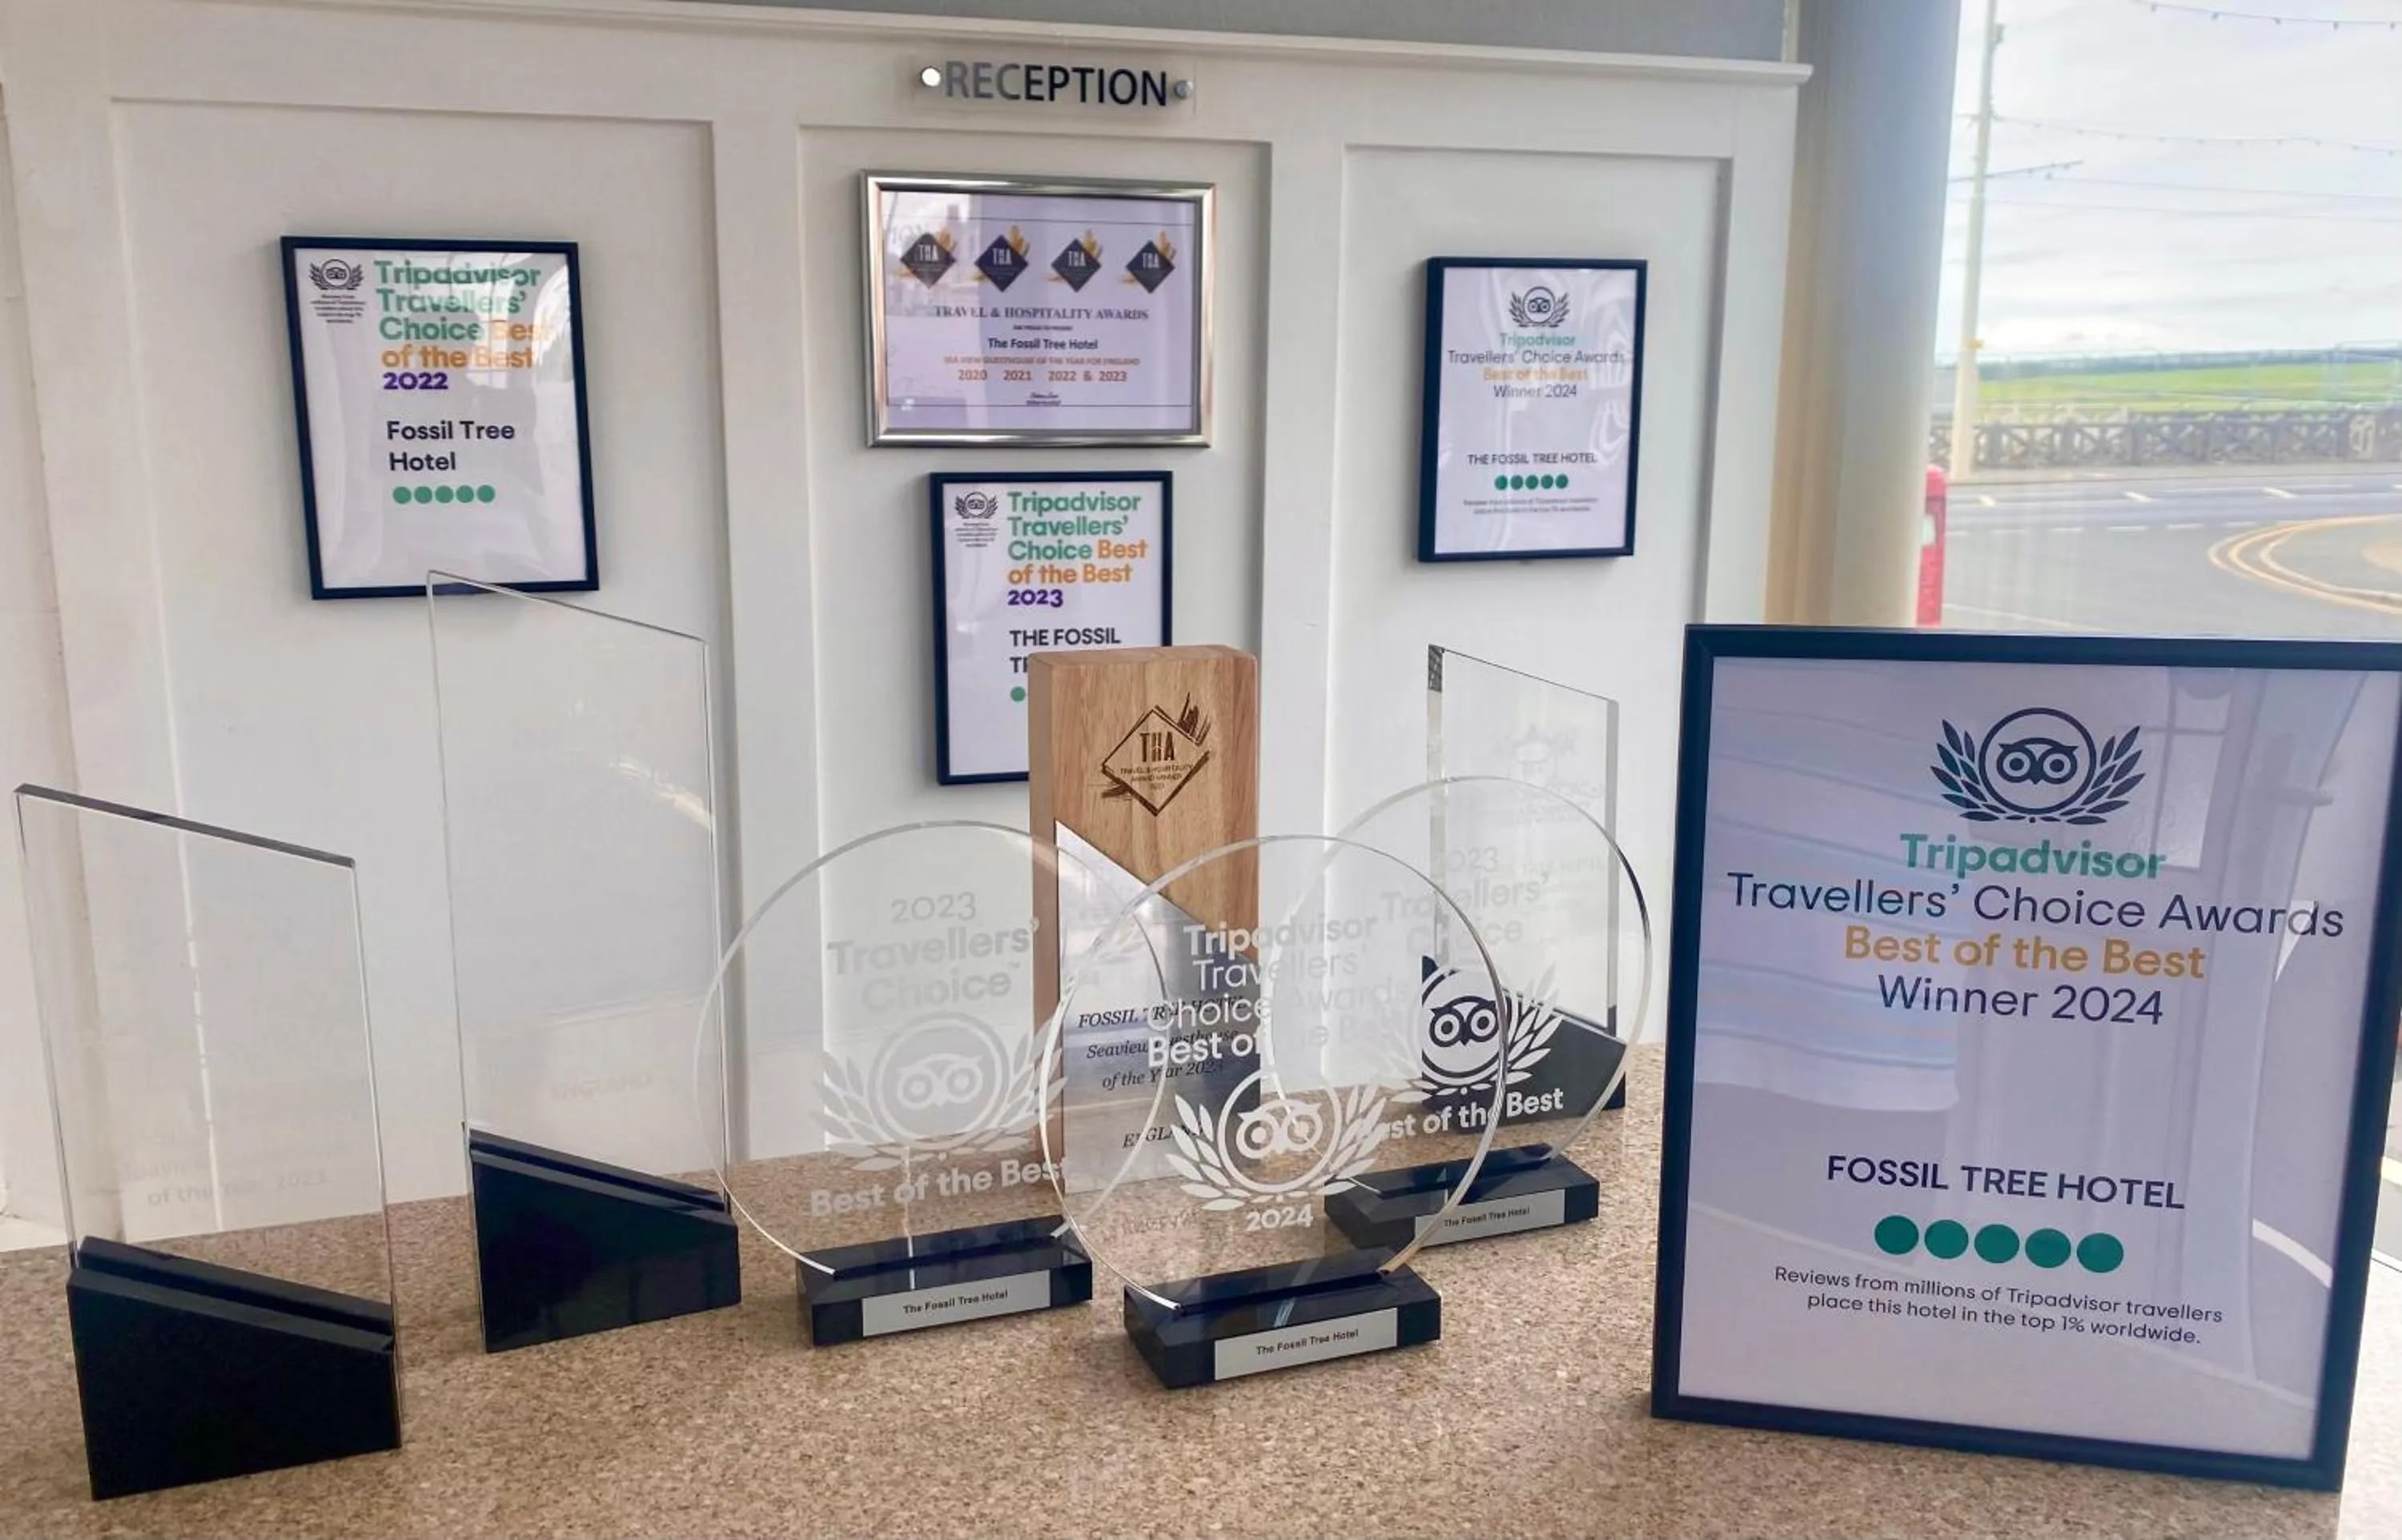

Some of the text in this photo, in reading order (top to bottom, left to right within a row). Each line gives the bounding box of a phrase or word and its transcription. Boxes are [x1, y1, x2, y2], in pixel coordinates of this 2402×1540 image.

[946, 60, 1167, 106] RECEPTION
[374, 259, 541, 289] Tripadvisor
[934, 306, 1149, 320] TRAVEL & HOSPITALITY AWARDS
[379, 316, 552, 342] Choice Bes
[1500, 333, 1576, 347] Tripadvisor
[382, 344, 535, 368] of the Best
[988, 338, 1099, 350] The Fossil Tree Hotel
[1522, 350, 1573, 363] Choice
[1575, 350, 1624, 362] Awards
[383, 372, 448, 390] 2022
[958, 369, 987, 380] 2020
[1003, 369, 1031, 381] 2021
[1048, 371, 1076, 381] 2022
[1099, 371, 1127, 382] 2023
[1484, 367, 1513, 380] Best
[1516, 367, 1532, 380] of
[1560, 367, 1589, 380] Best
[1493, 384, 1577, 398] Winner 2024
[387, 420, 515, 440] Fossil Tree
[389, 452, 456, 471] Hotel
[1467, 451, 1597, 465] THE FOSSIL TREE HOTEL
[1006, 491, 1141, 517] Tripadvisor
[1007, 539, 1148, 560] Choice Best
[1008, 563, 1133, 584] of the Best
[1007, 589, 1063, 608] 2023
[1009, 628, 1121, 647] THE FOSSIL
[1139, 731, 1175, 762] THA
[1431, 845, 1500, 873] 023
[1900, 832, 2165, 880] Tripadvisor
[891, 891, 977, 923] 2023
[1974, 883, 2145, 929] Choice
[2159, 892, 2343, 937] Awards
[1183, 912, 1378, 960] Tripadvisor
[1845, 924, 2205, 978] Best of the Best
[1878, 974, 2163, 1025] Winner 2024
[1078, 1009, 1139, 1029] FOSSIL
[1147, 993, 1272, 1033] Choice
[1147, 1033, 1223, 1067] Best
[1102, 1073, 1119, 1090] of
[1121, 1069, 1146, 1087] the
[1149, 1065, 1183, 1082] Yar
[1422, 1104, 1452, 1135] of
[1506, 1087, 1565, 1118] Best
[810, 1185, 889, 1216] Best
[894, 1173, 930, 1203] of
[935, 1166, 992, 1197] the
[1826, 1155, 2185, 1209] FOSSIL TREE HOTEL
[1245, 1202, 1314, 1232] 2024
[1444, 1206, 1530, 1227] The Fossil Tree Hotel
[902, 1289, 1008, 1314] The Fossil Tree Hotel
[1774, 1265, 2223, 1323] Reviews from millions of Tripadvisor travellers
[1807, 1292, 2202, 1345] place this hotel in the top 1% worldwide.
[1255, 1329, 1359, 1355] The Fossil Tree Hotel
